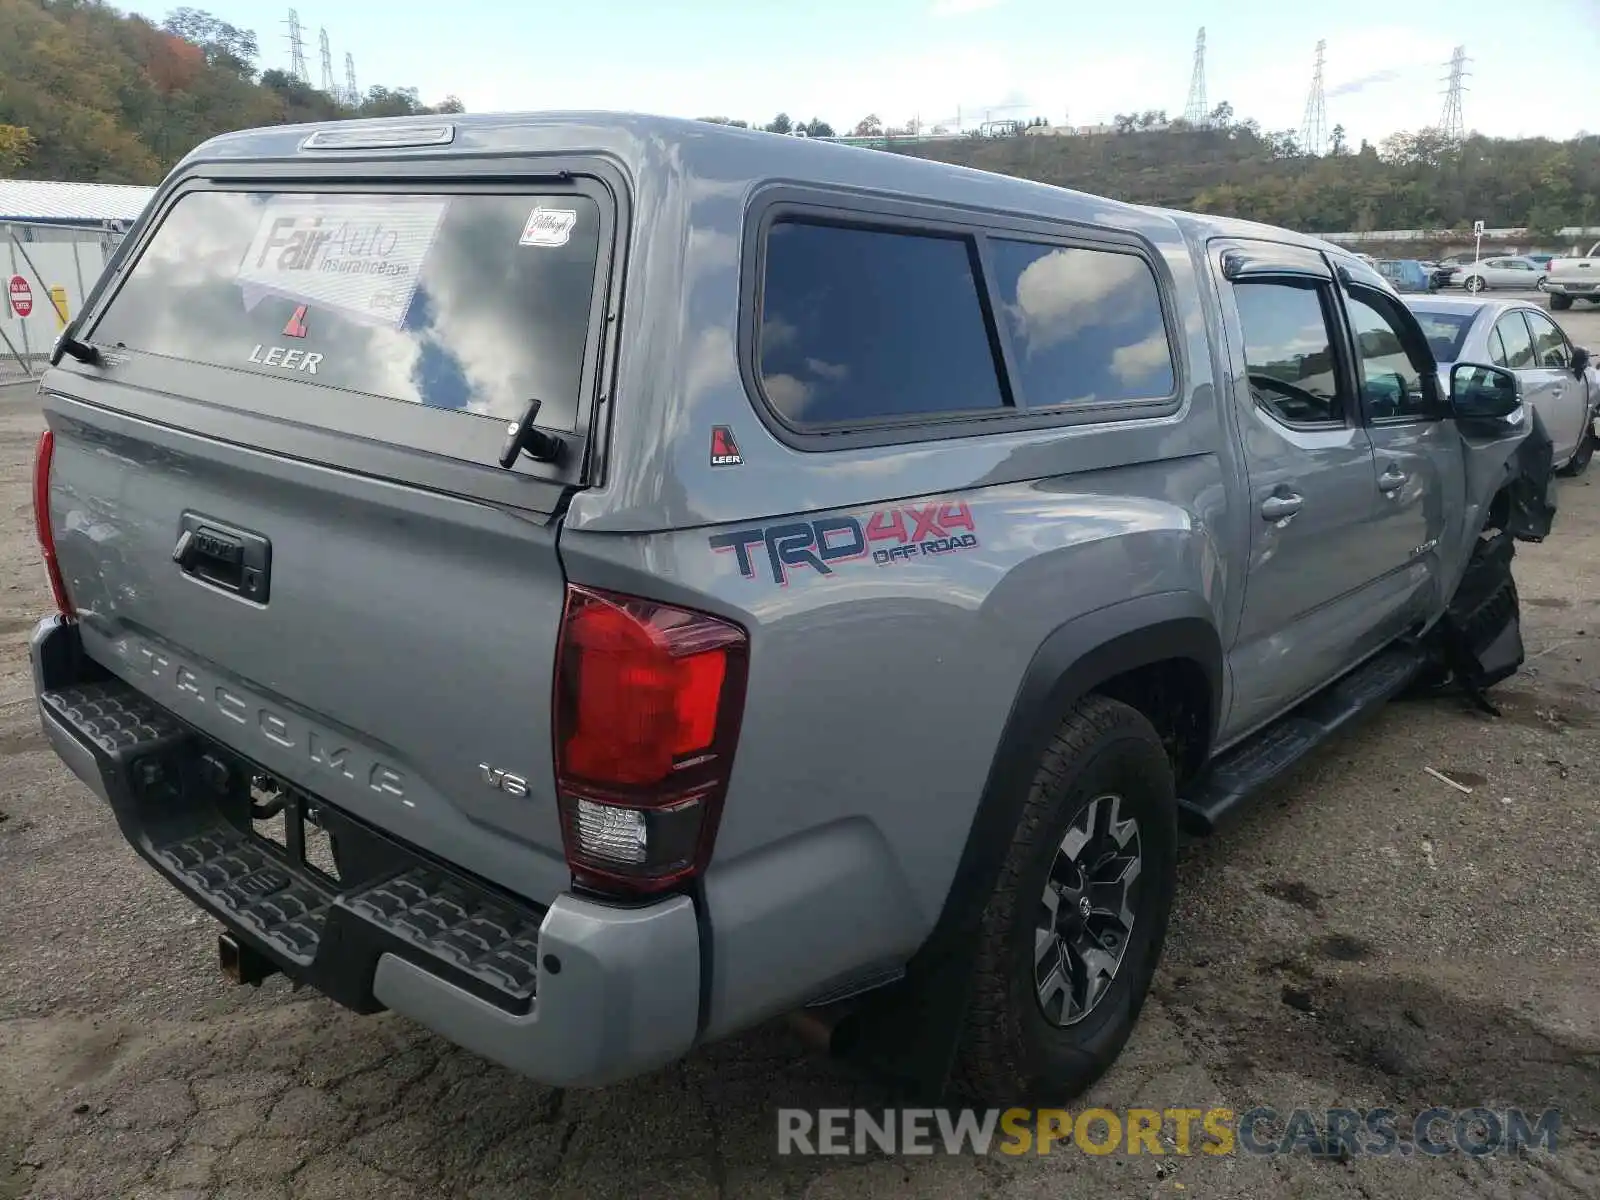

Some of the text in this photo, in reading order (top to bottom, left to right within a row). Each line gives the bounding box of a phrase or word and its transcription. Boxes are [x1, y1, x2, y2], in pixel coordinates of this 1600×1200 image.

[15, 302, 30, 310] ENTER
[247, 343, 324, 375] LEER
[712, 455, 741, 464] LEER
[709, 516, 868, 587] TRD
[872, 533, 979, 566] OFF ROAD
[479, 762, 527, 797] V6
